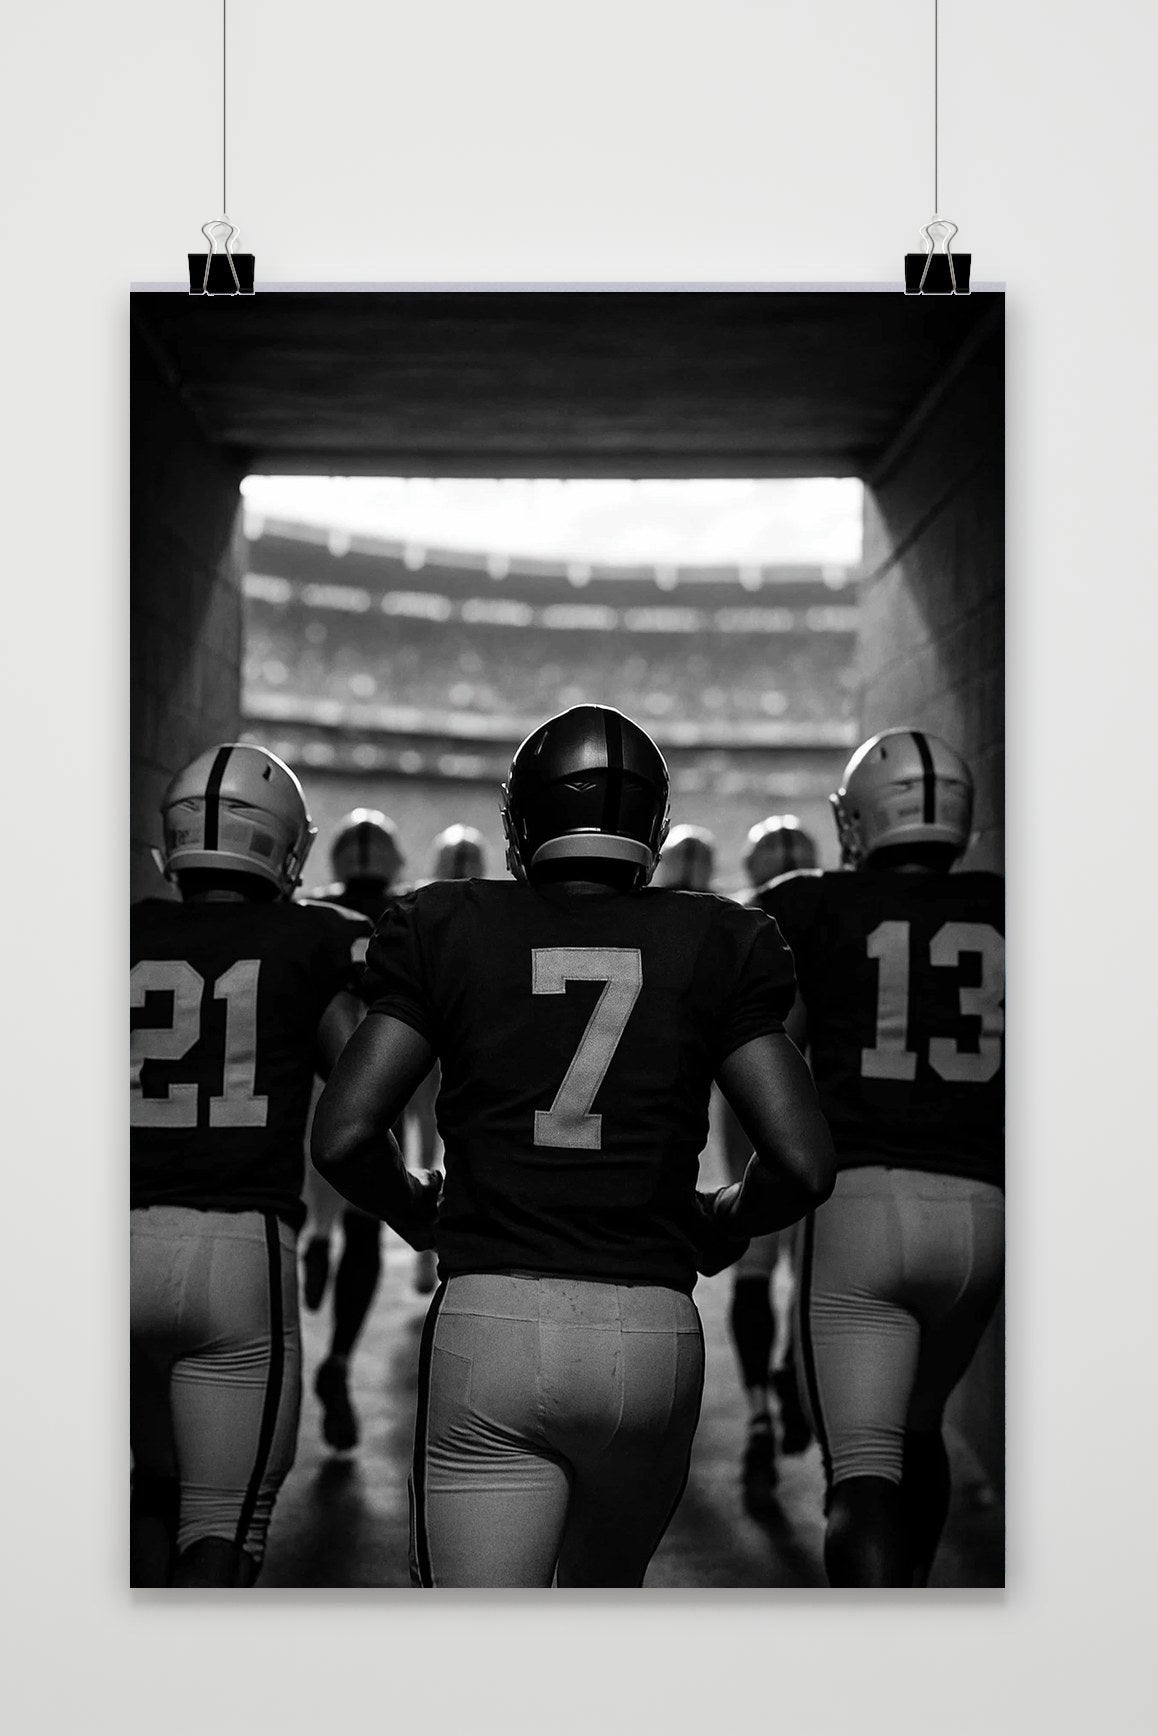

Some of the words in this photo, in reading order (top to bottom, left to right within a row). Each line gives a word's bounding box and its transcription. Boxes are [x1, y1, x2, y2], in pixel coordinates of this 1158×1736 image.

[130, 959, 268, 1127] 21
[531, 947, 643, 1150] 7
[860, 920, 1005, 1083] 13
